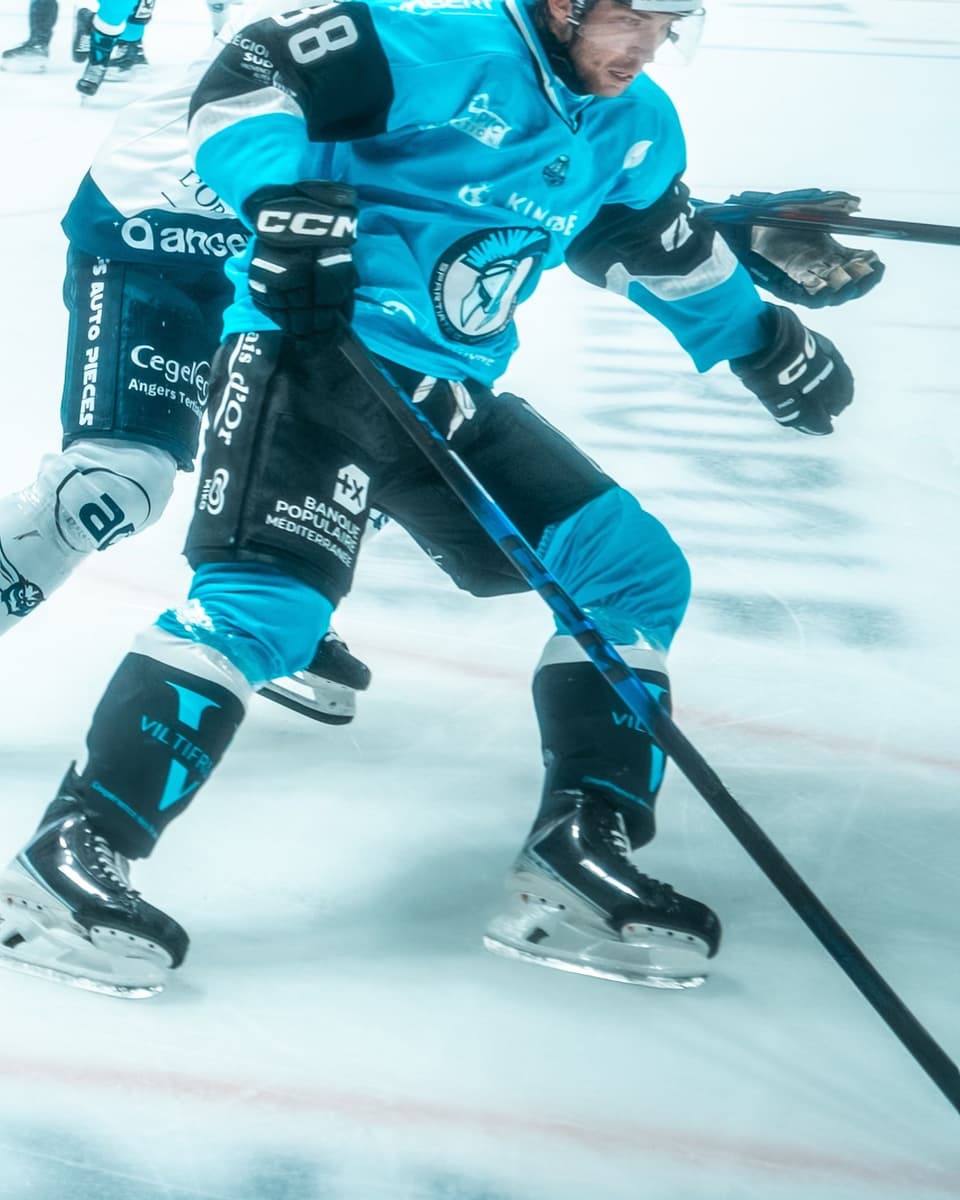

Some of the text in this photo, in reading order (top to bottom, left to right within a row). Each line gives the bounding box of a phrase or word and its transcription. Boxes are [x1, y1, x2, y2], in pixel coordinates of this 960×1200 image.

[242, 52, 275, 69] SUD
[256, 209, 358, 240] CCM
[87, 281, 105, 341] AUTO
[78, 346, 100, 427] PIECES
[128, 378, 177, 400] Angers
[275, 499, 361, 554] POPULAIRE
[304, 495, 361, 537] BANQUE
[141, 714, 215, 777] VILTIFR
